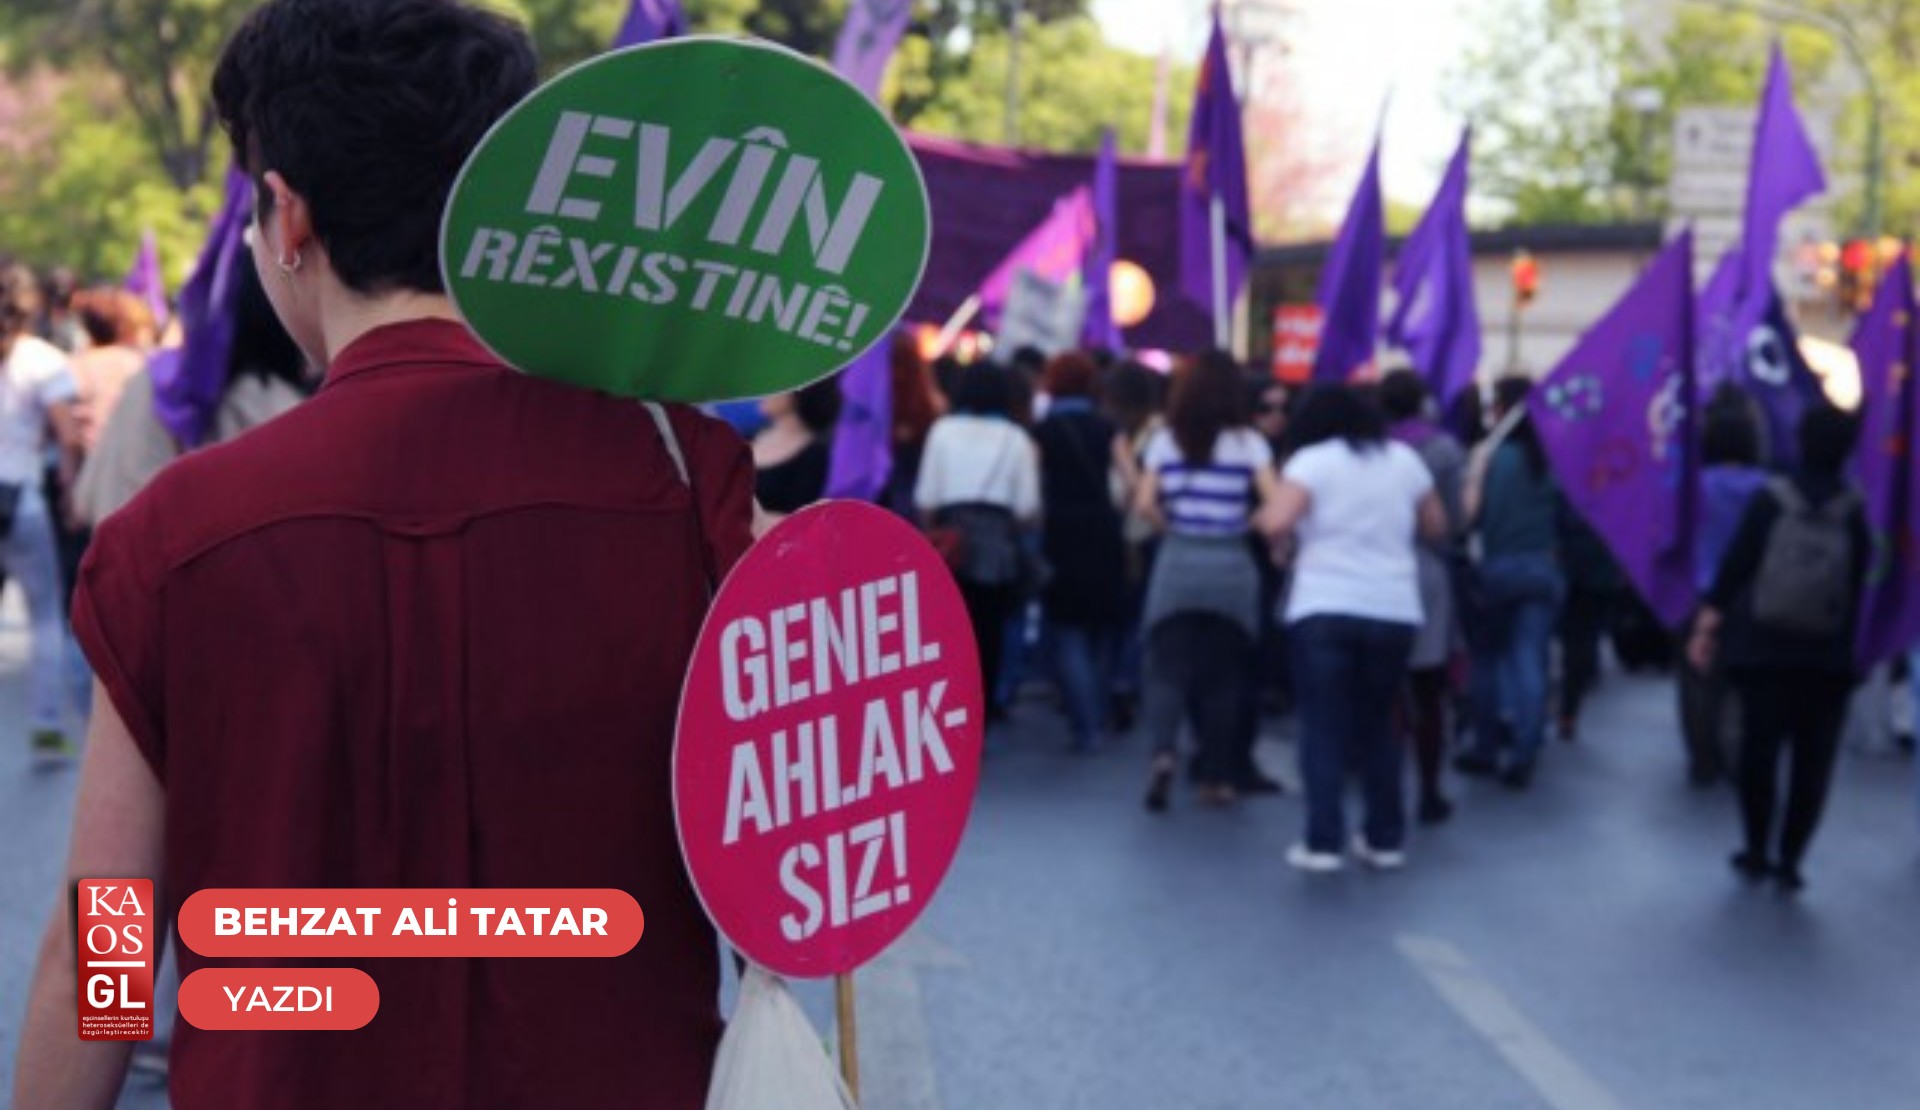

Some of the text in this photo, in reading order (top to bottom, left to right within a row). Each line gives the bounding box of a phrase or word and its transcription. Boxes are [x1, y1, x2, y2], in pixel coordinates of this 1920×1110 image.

[525, 111, 885, 275] EVÎN
[460, 225, 871, 351] RÊXISTINÊ!
[719, 570, 941, 721] GENEL
[722, 679, 968, 845] AHLAK-
[778, 811, 911, 942] SIZ!
